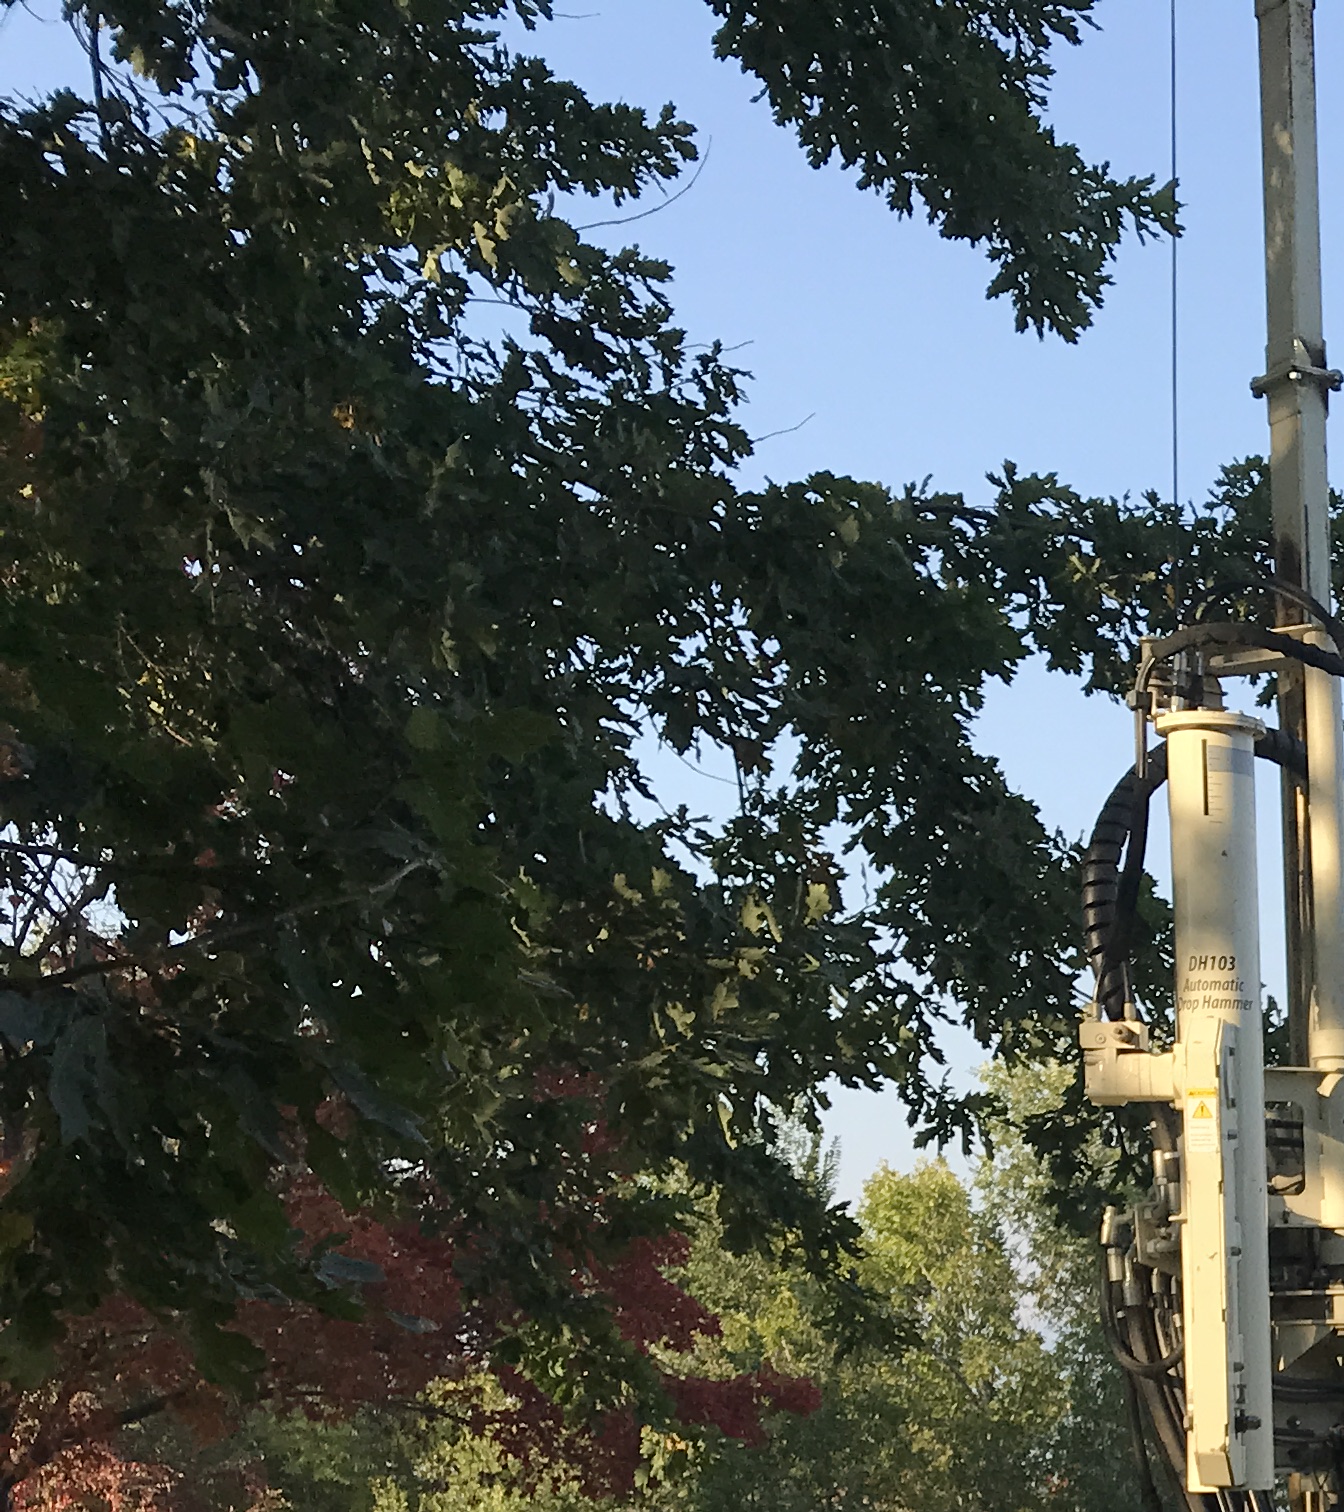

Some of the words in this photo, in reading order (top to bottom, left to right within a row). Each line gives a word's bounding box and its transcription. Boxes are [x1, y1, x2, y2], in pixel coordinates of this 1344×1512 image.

[1188, 955, 1236, 972] DH103
[1183, 977, 1244, 992] Automatic
[1202, 995, 1253, 1011] Hammer
